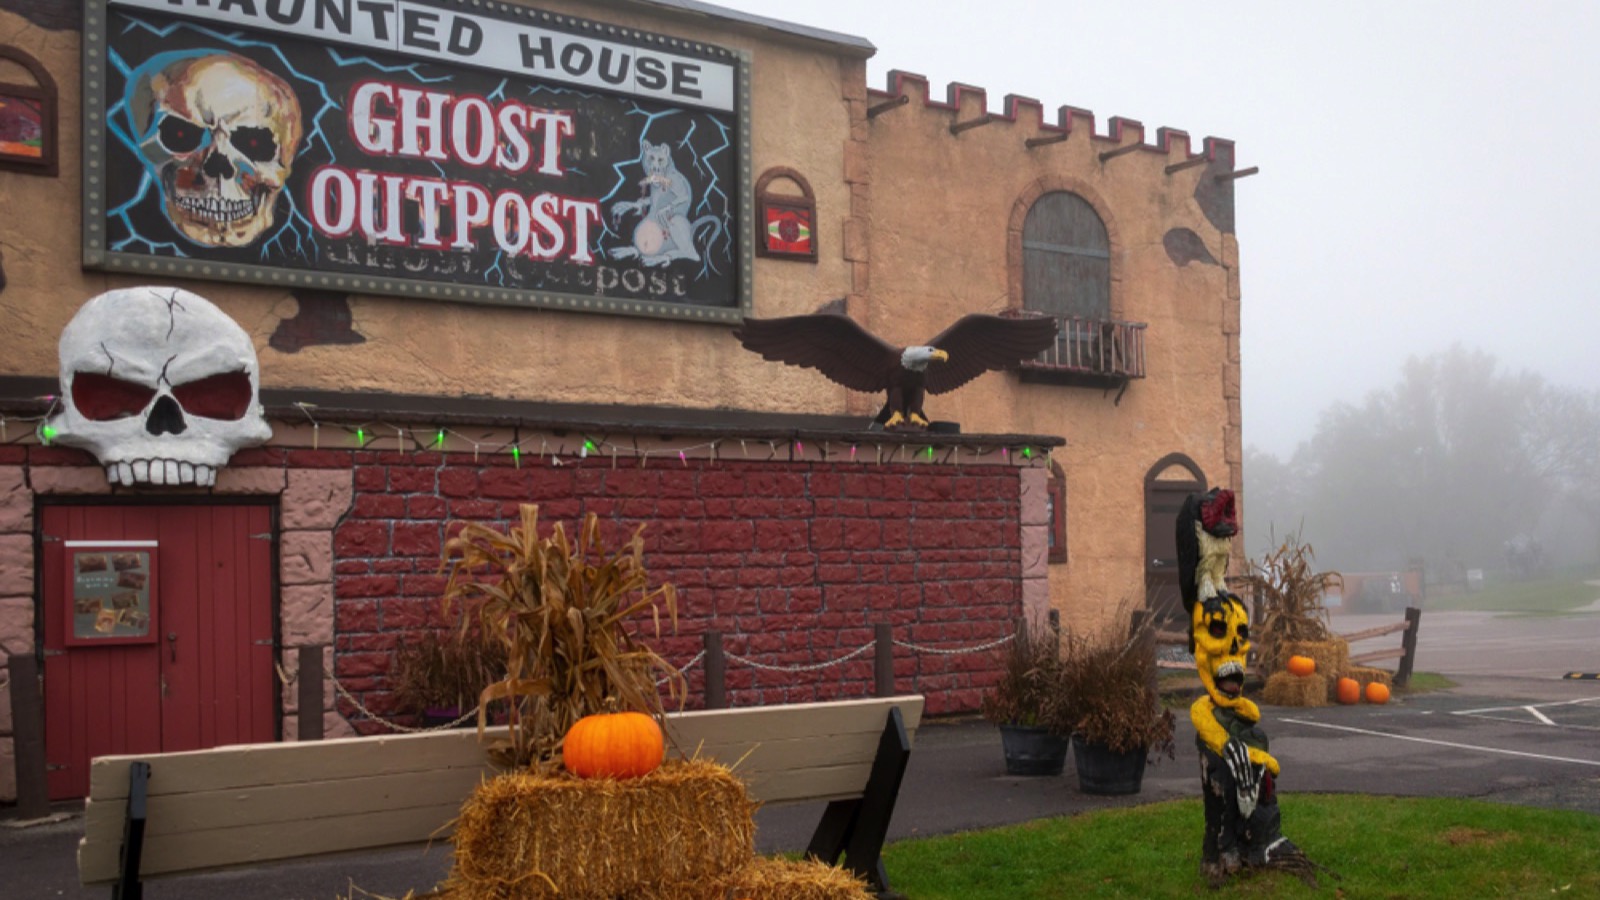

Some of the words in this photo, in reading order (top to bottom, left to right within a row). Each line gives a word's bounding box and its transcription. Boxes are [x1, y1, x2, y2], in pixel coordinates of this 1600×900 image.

[167, 0, 484, 57] UNTED
[518, 33, 703, 100] HOUSE
[349, 79, 576, 178] GHOST
[309, 165, 599, 265] OUTPOST
